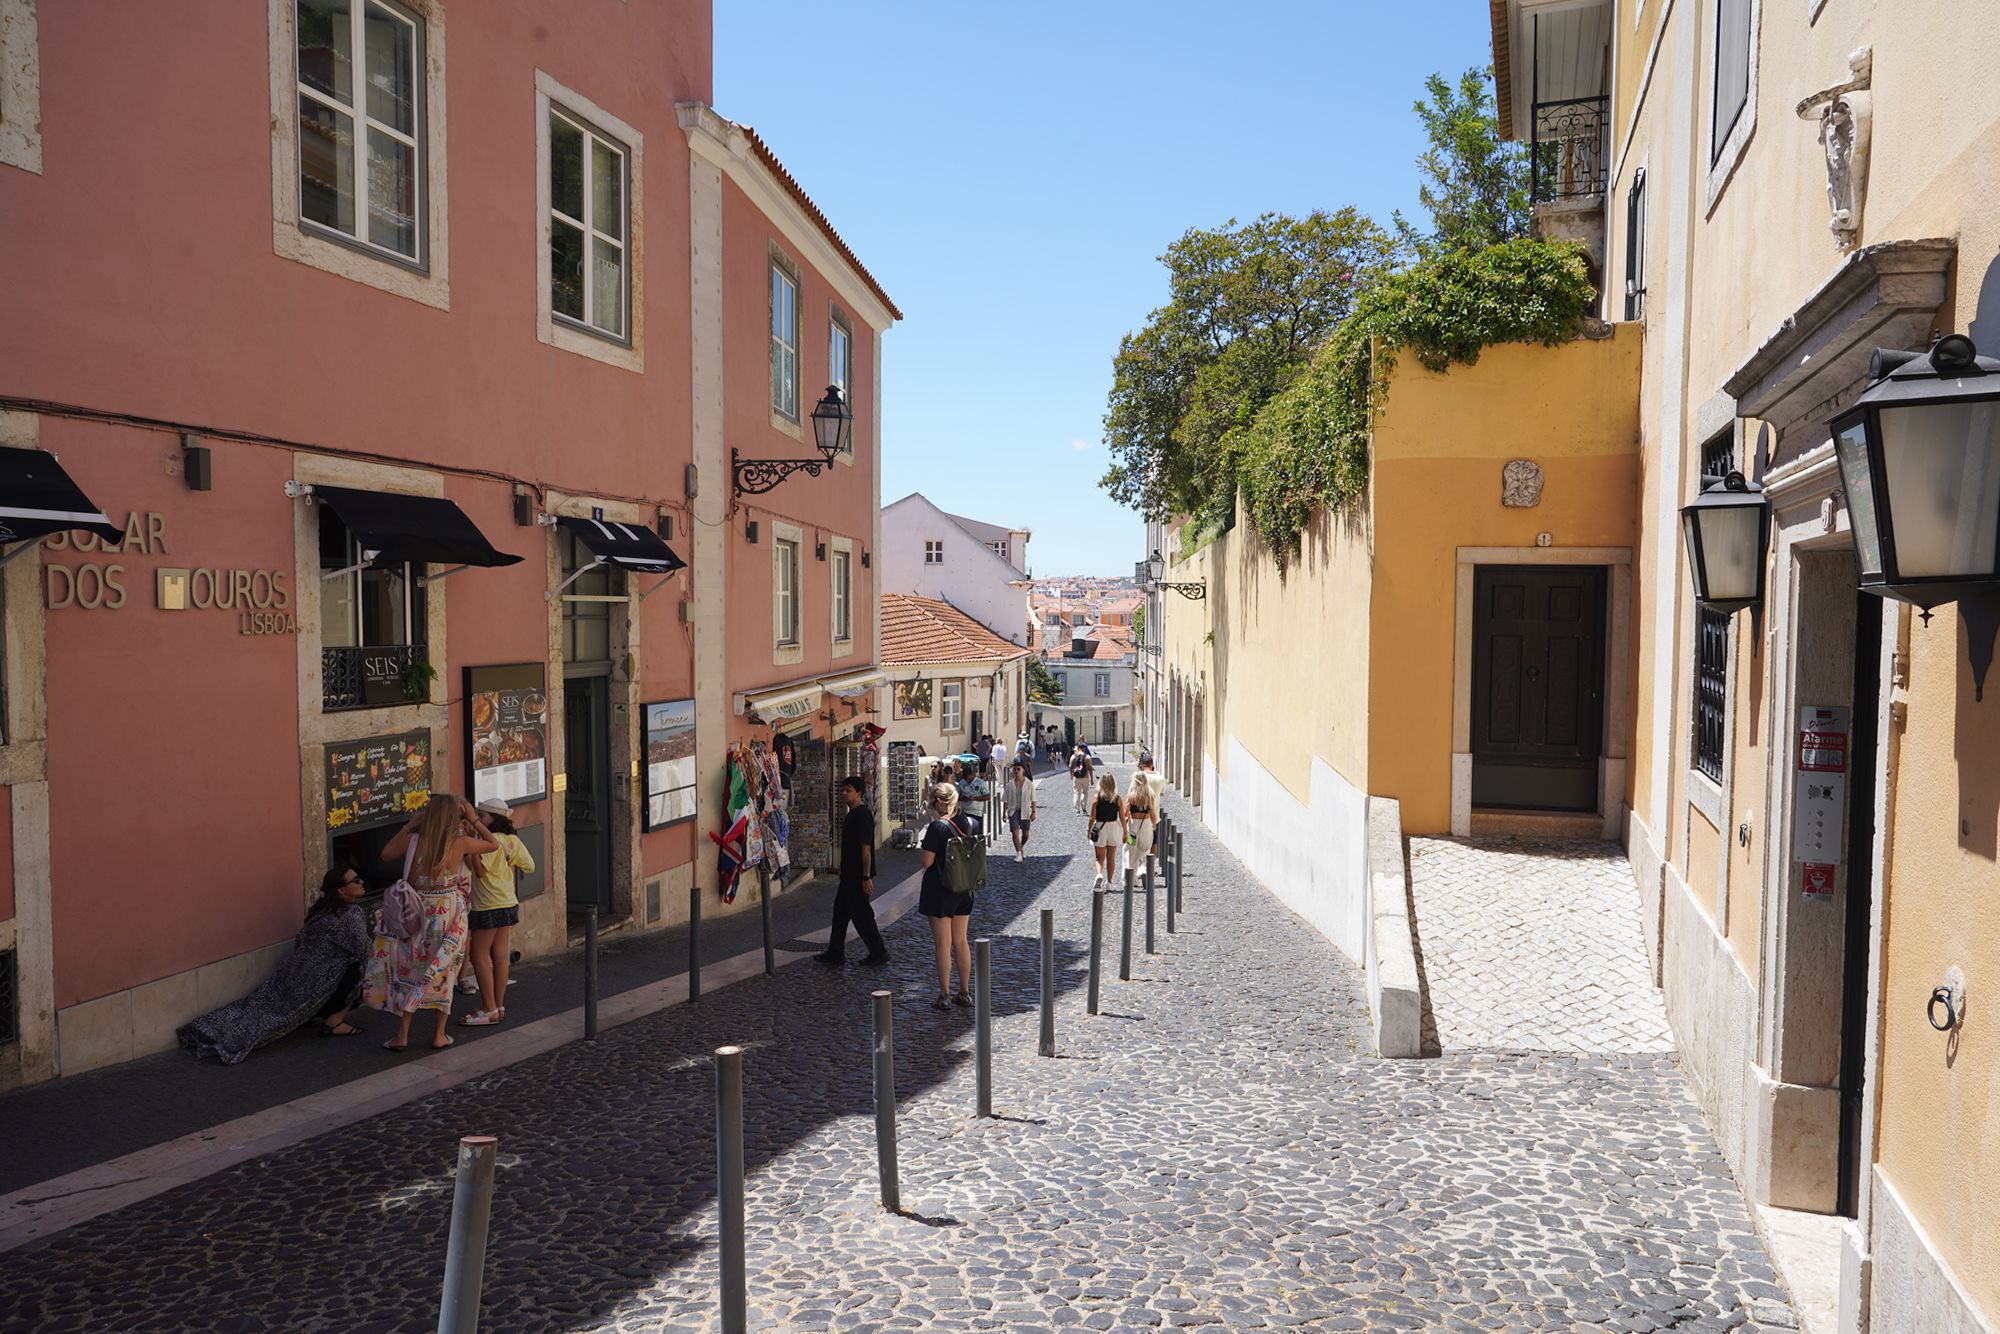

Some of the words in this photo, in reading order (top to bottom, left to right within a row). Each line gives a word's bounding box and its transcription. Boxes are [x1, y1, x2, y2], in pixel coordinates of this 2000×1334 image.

[47, 564, 127, 610] DOS
[242, 613, 295, 635] LISBOA
[365, 656, 399, 676] SEIS
[501, 696, 520, 708] SEIS
[1803, 733, 1844, 745] Alarme
